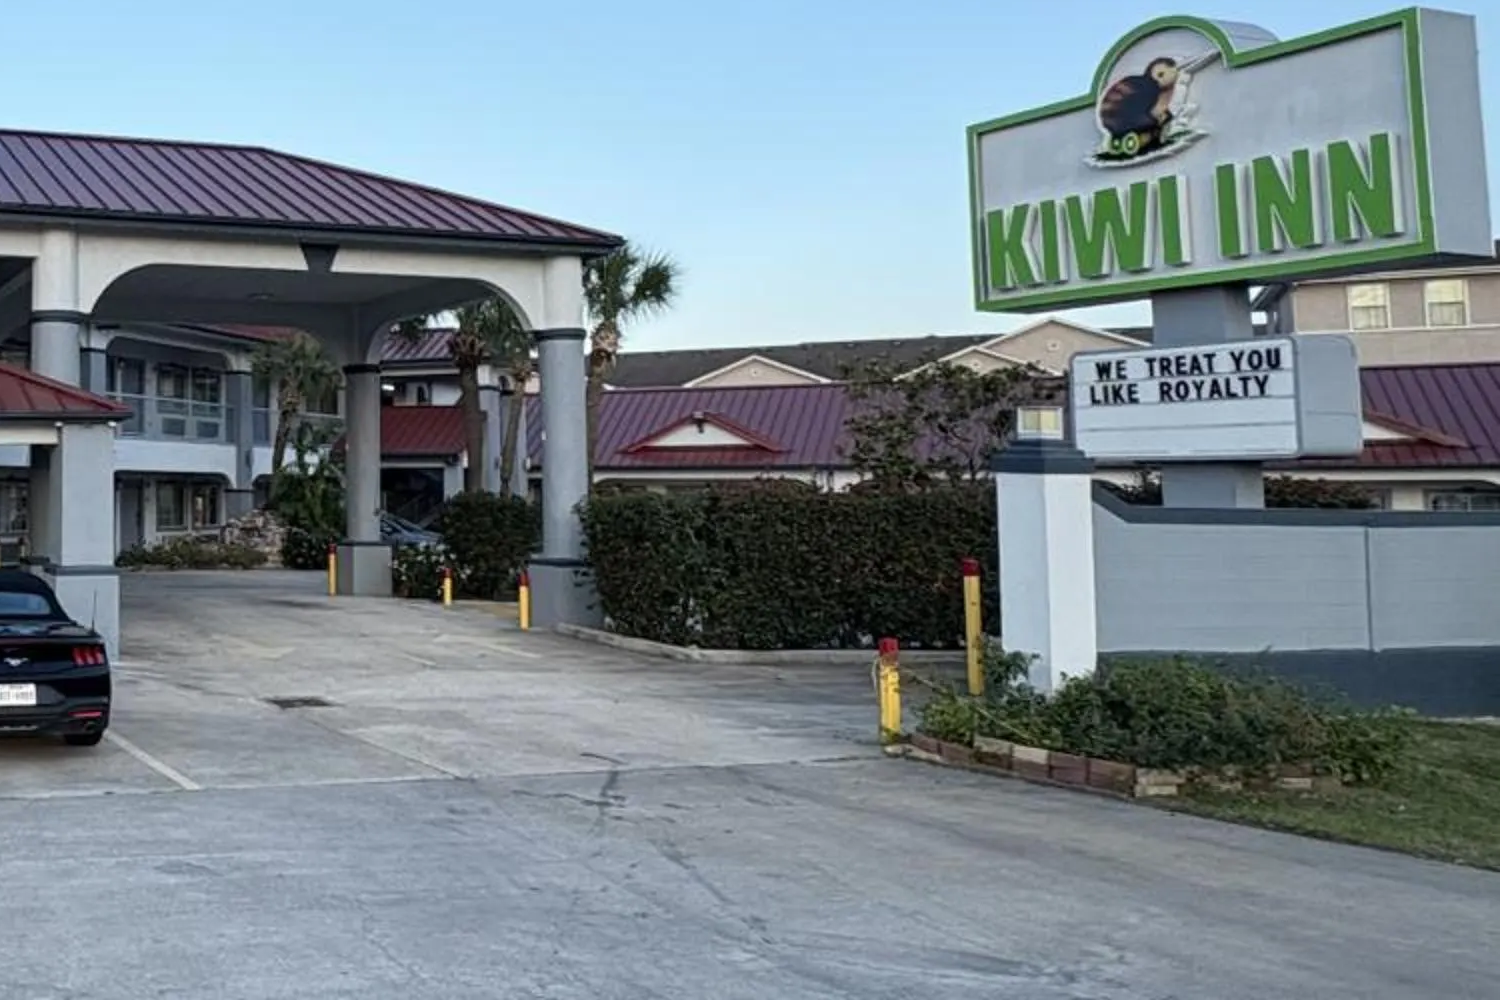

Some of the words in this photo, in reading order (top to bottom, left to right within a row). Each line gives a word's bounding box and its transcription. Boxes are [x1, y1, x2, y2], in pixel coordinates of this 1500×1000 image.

[986, 175, 1187, 289] KIWI
[1215, 132, 1398, 258] INN
[1095, 361, 1128, 381] WE
[1144, 353, 1216, 376] TREAT
[1229, 347, 1281, 371] YOU
[1089, 383, 1140, 406] LIKE
[1159, 374, 1269, 402] ROYALTY
